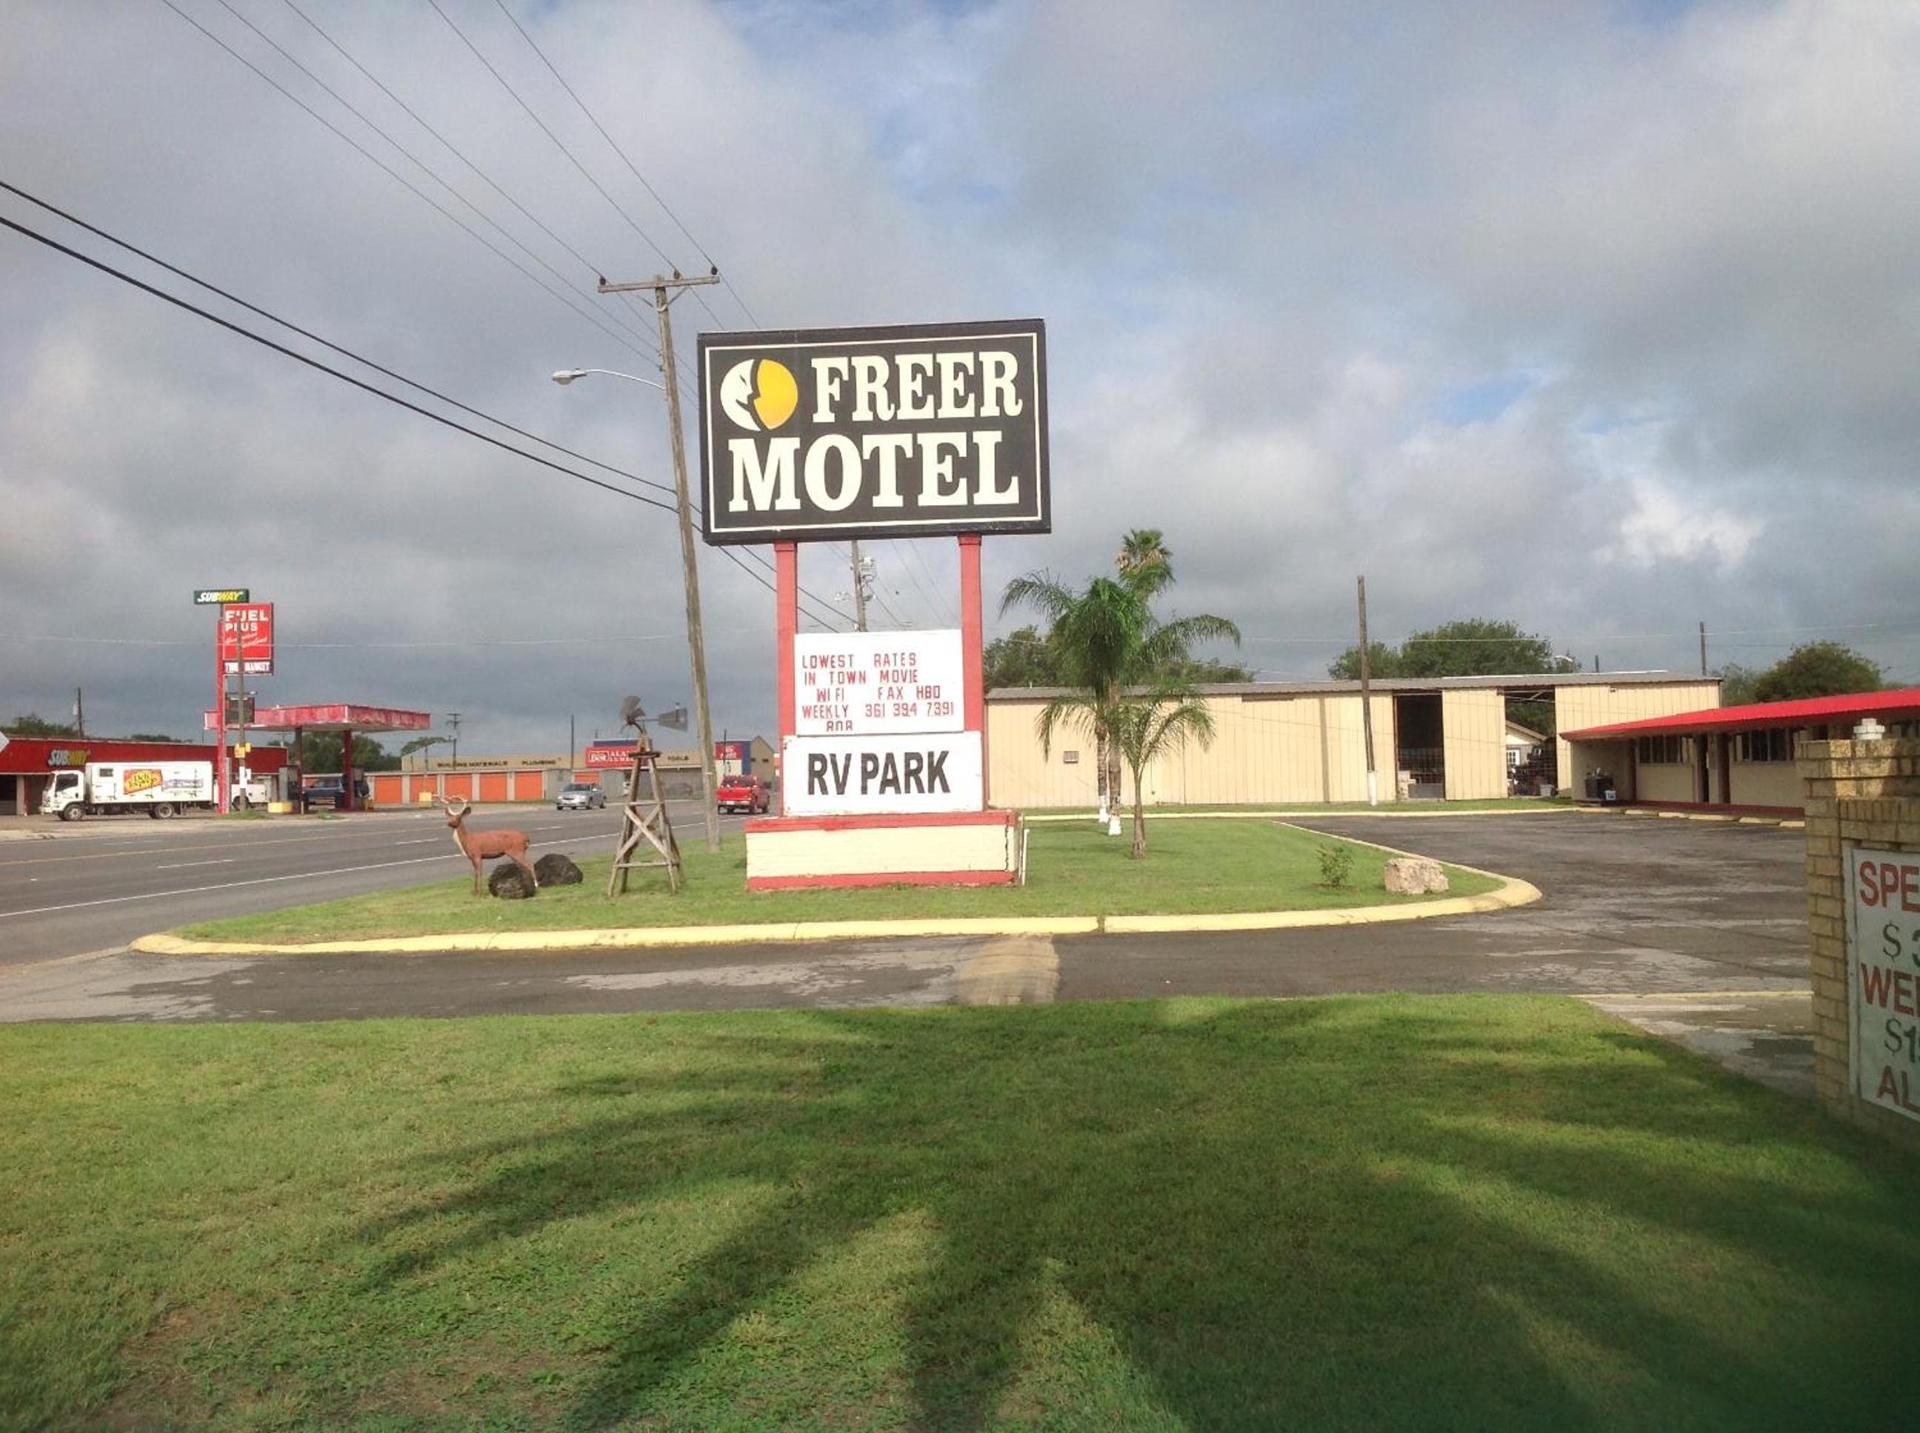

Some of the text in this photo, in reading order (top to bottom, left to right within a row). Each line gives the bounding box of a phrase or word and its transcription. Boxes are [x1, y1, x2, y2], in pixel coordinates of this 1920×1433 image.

[811, 351, 1023, 423] FREER
[728, 430, 1020, 512] MOTEL
[197, 591, 243, 602] SUBWAY
[802, 652, 917, 669] LOWEST RATES
[804, 668, 919, 686] IN TOWN MOVIE
[877, 686, 904, 700] FAX
[915, 685, 941, 700] HBO
[802, 701, 954, 719] WEEKLY 361 394 7391
[48, 750, 89, 766] SUBWAY
[808, 750, 951, 795] RV PARK
